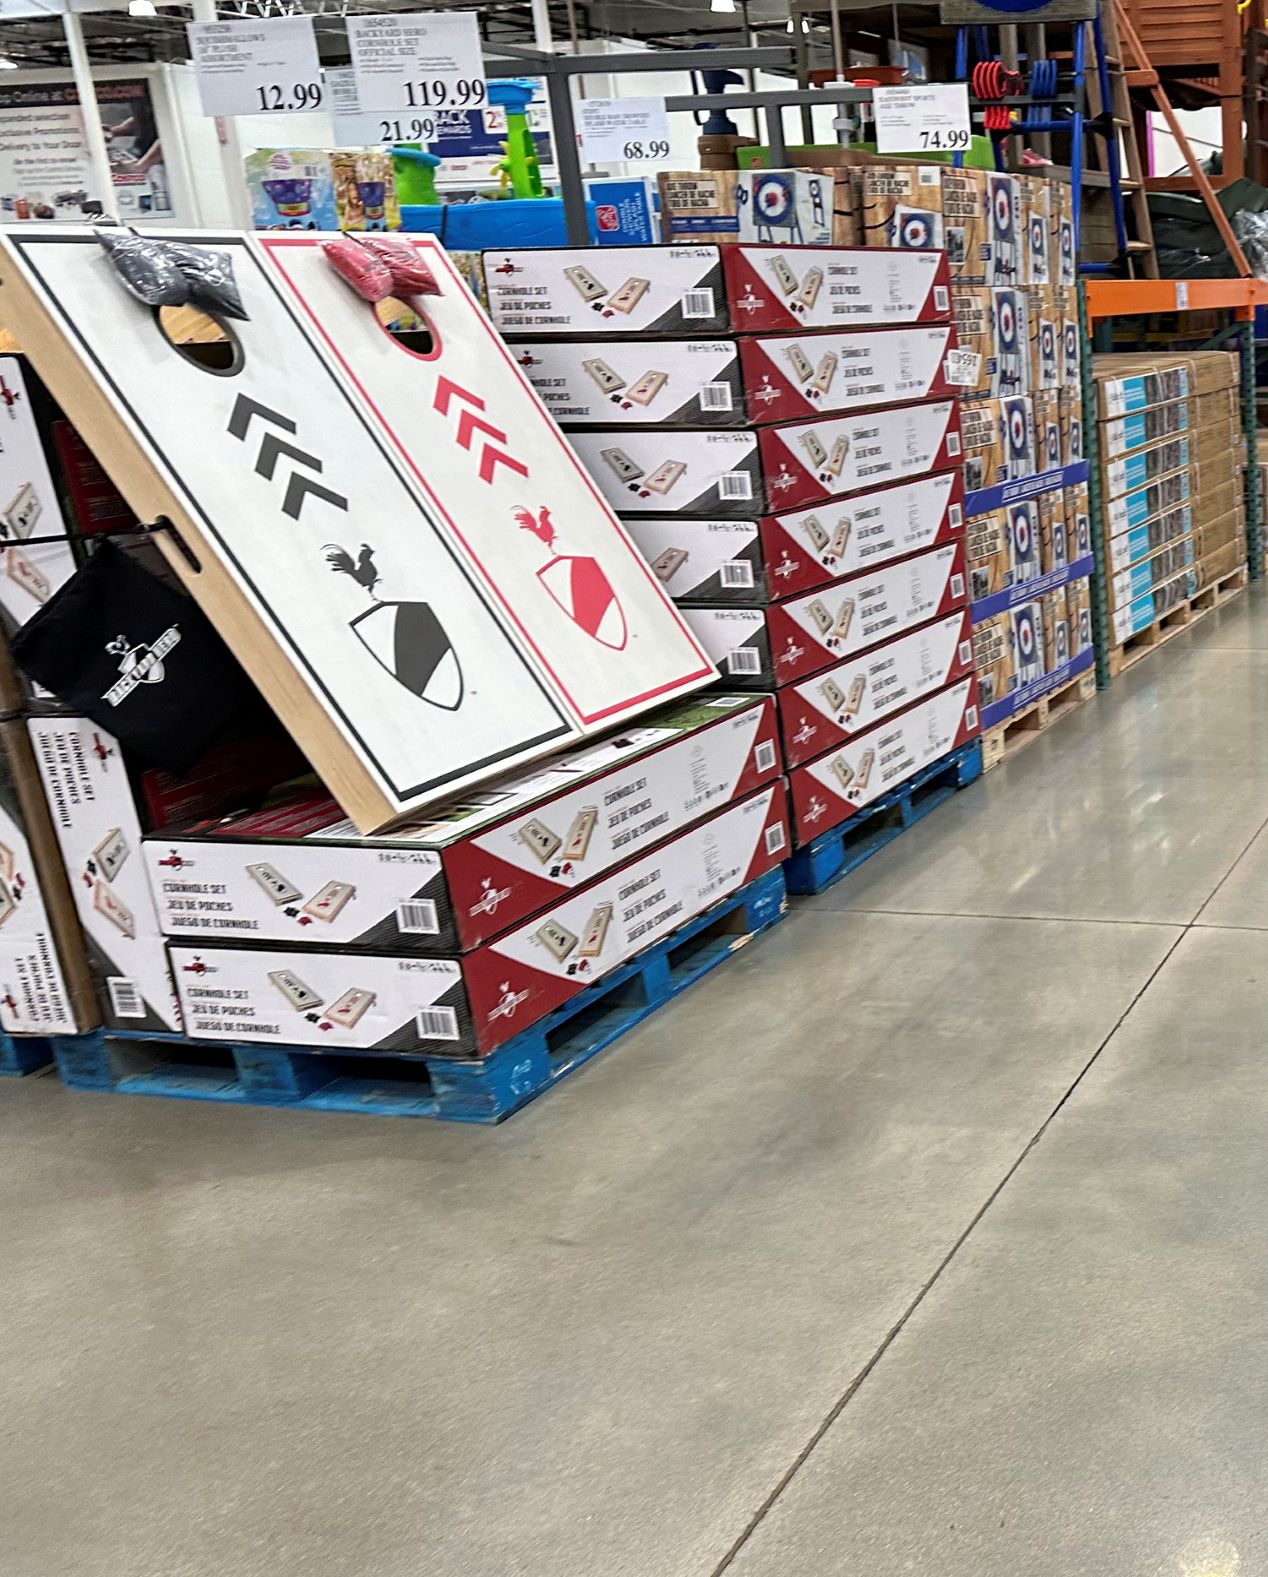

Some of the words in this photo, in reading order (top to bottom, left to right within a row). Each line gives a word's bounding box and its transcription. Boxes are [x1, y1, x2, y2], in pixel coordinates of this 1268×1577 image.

[257, 83, 323, 110] 12.99
[403, 79, 486, 106] 119.99
[380, 119, 435, 142] 21.99
[438, 125, 472, 134] EWARDS
[920, 130, 969, 149] 74.99
[624, 140, 669, 160] 68.99
[498, 287, 536, 296] CORNHOLE
[537, 286, 547, 295] SET
[500, 302, 514, 310] JEU
[515, 302, 523, 310] DE
[526, 301, 551, 310] POCHES
[502, 317, 523, 325] JUEGO
[525, 316, 533, 325] DE
[534, 315, 570, 325] CORNHOLE
[531, 379, 551, 387] NHOLE
[53, 732, 65, 750] JEU
[38, 732, 54, 763] JUEGO
[59, 752, 69, 764] DE
[47, 766, 59, 777] DE
[69, 731, 91, 781] CORNHOLE
[82, 784, 95, 801] SET
[63, 767, 82, 804] POCHES
[51, 780, 73, 828] CORNHOLE
[162, 883, 208, 893] CORNHOLE
[210, 884, 226, 894] SET
[168, 900, 184, 910] JEU
[186, 900, 197, 910] DE
[198, 901, 233, 911] POCHES
[171, 917, 199, 927] JUEGO
[200, 918, 212, 927] DE
[213, 919, 259, 929] CORNHOLE
[187, 988, 231, 998] CORNHOLE
[233, 990, 249, 999] SET
[192, 1004, 207, 1013] JEU
[209, 1005, 220, 1014] DE
[222, 1006, 256, 1016] POCHES
[196, 1021, 223, 1030] JUEGO
[224, 1022, 235, 1031] DE
[236, 1023, 281, 1034] CORNHOLE
